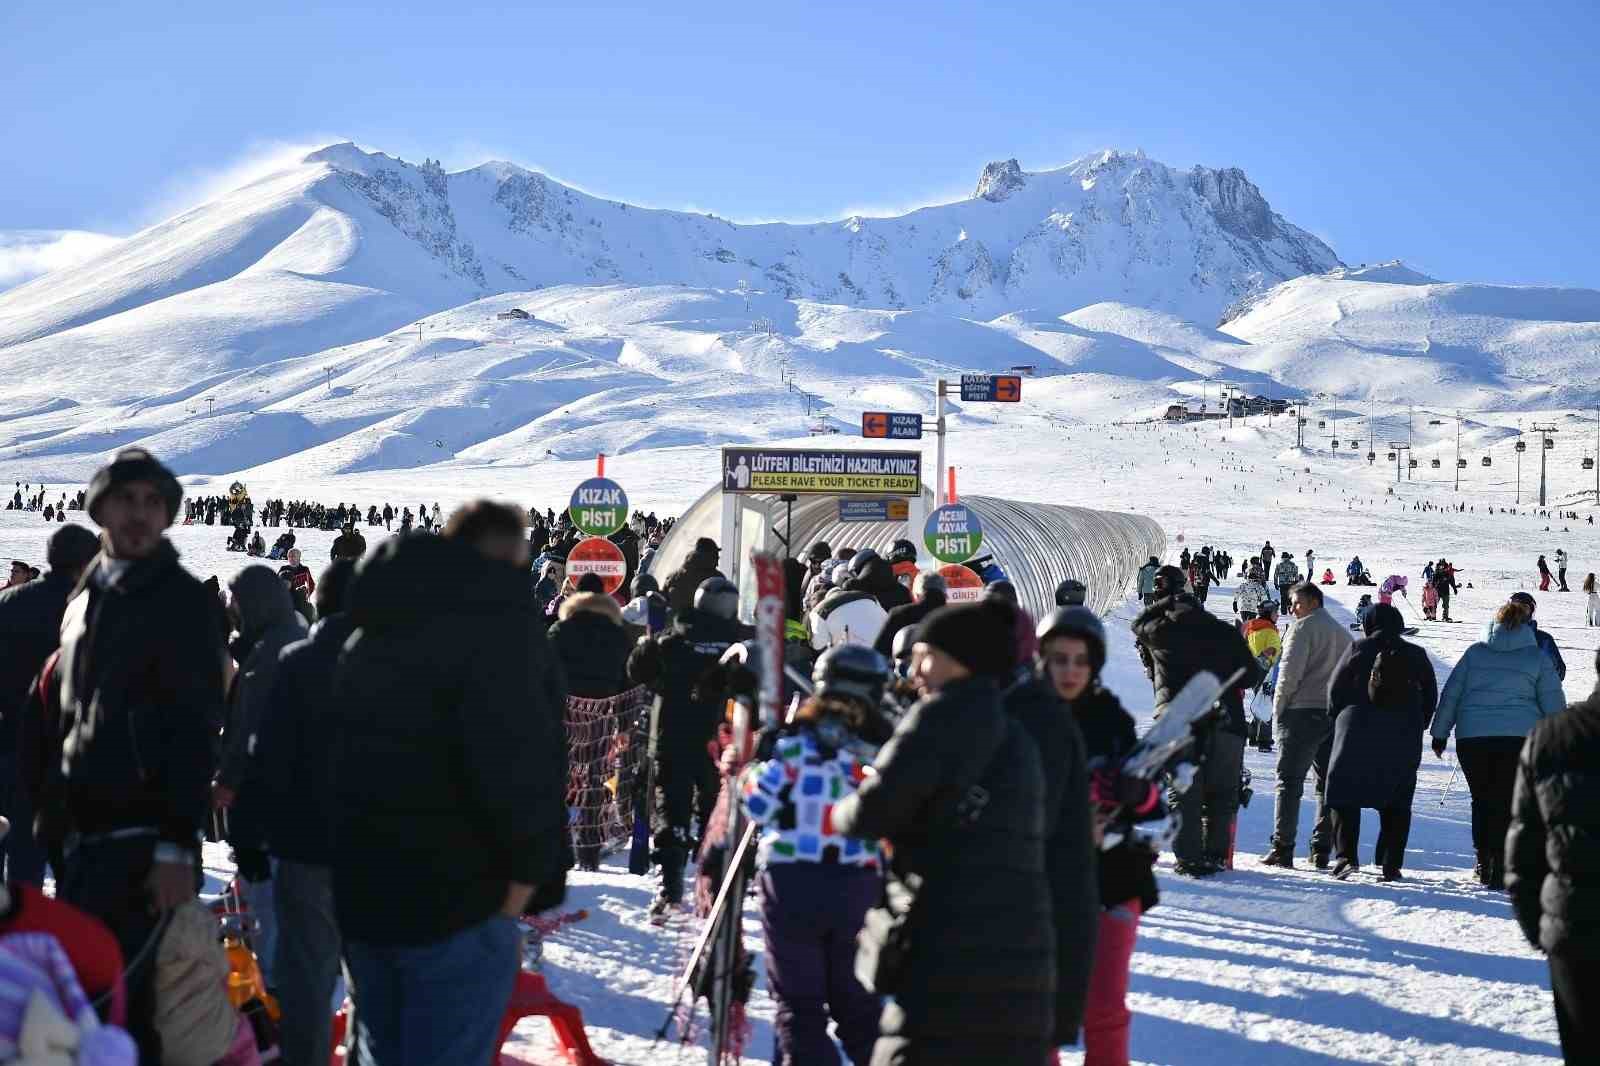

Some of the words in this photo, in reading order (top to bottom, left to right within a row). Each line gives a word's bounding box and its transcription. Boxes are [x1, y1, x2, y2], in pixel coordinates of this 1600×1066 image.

[892, 416, 917, 426] KIZAK
[892, 427, 918, 436] ALANI
[751, 453, 790, 472] LÜTFEN
[792, 453, 845, 473] BİLETİNİZİ
[847, 456, 917, 474] HAZIRLAYINIZ
[752, 475, 788, 486] PLEASE
[790, 476, 816, 487] HAVE
[818, 477, 844, 487] YOUR
[846, 477, 881, 488] TICKET
[883, 478, 914, 489] READY
[579, 488, 620, 505] KIZAK
[581, 508, 616, 527] PİSTİ
[937, 521, 968, 533] KAYAK
[936, 534, 971, 554] PİSTİ
[574, 564, 618, 573] BEKLEMEK
